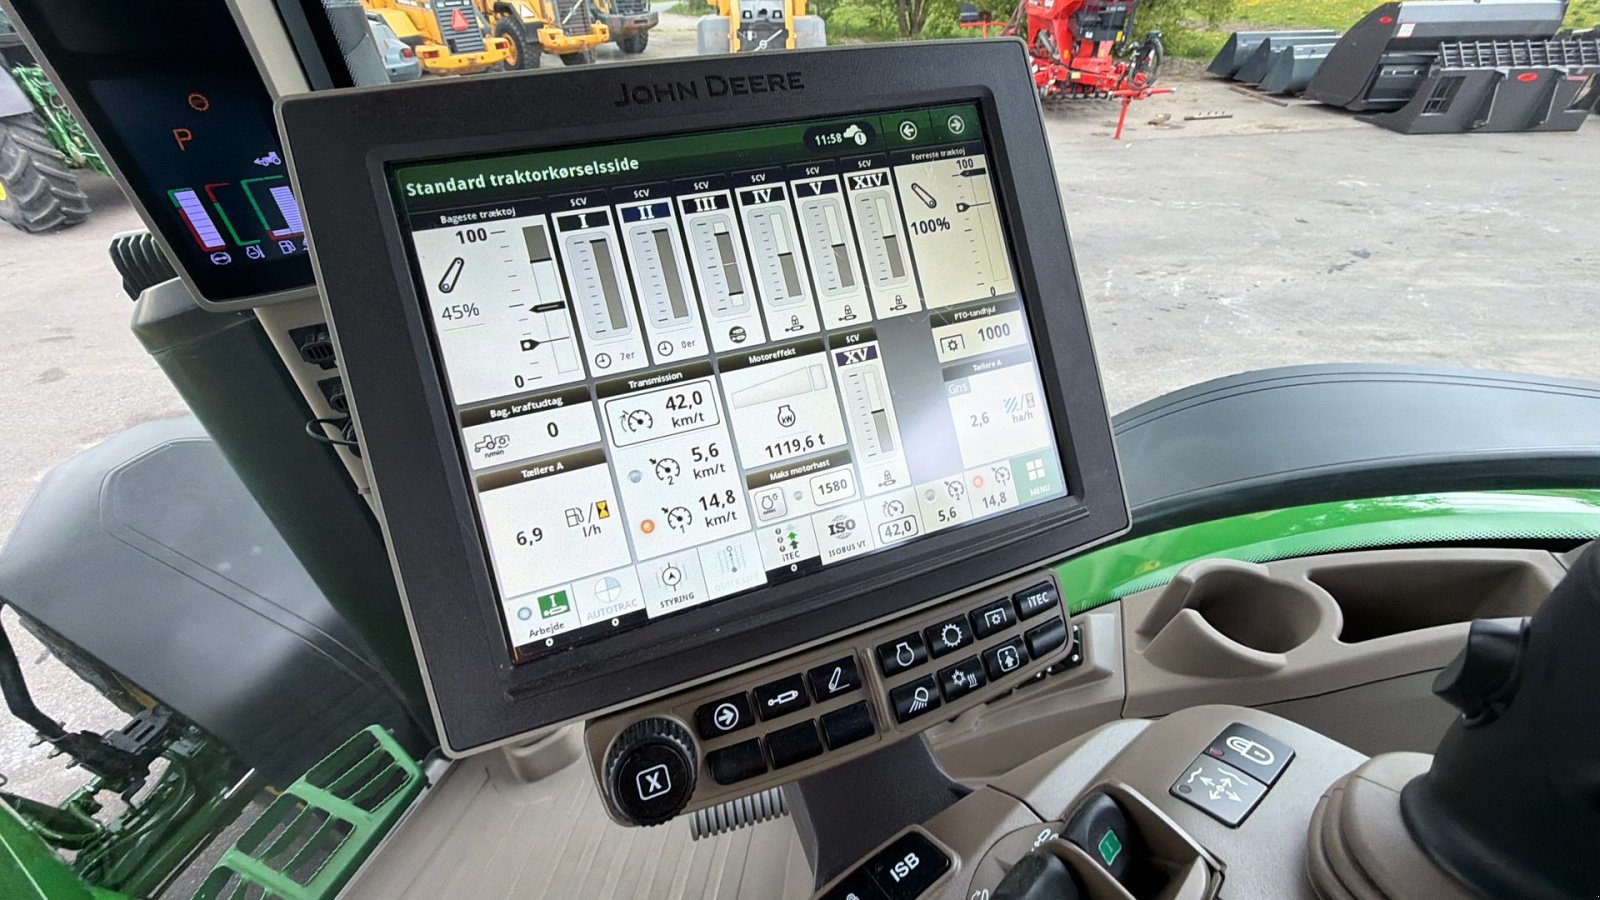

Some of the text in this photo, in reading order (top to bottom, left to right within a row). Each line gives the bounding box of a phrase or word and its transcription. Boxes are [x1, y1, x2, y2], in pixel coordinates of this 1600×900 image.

[614, 71, 805, 107] JOHN DEERE
[172, 128, 193, 151] P
[815, 132, 842, 146] 11:58
[857, 159, 872, 169] SCV
[911, 151, 939, 162] Forreste
[956, 158, 974, 170] 100
[406, 157, 639, 197] Standard traktorkørselsside
[751, 173, 766, 183] SCV
[805, 166, 820, 176] SCV
[693, 180, 709, 191] SCV
[808, 181, 823, 196] V
[853, 173, 884, 190] XIV
[570, 196, 587, 207] SCV
[633, 188, 650, 199] SCV
[752, 188, 772, 204] IV
[637, 205, 655, 220] II
[694, 196, 718, 212] III
[440, 211, 477, 225] Bageste
[911, 217, 951, 236] 100%
[455, 227, 488, 245] 100
[989, 286, 996, 297] 0
[441, 302, 480, 321] 45%
[954, 305, 996, 321] PTO-tandhjul
[845, 333, 860, 344] SCV
[977, 322, 1011, 343] 1000
[748, 347, 797, 365] Motoreffekt
[844, 348, 869, 365] XV
[996, 359, 1003, 367] A
[514, 374, 525, 389] 0
[628, 371, 684, 390] Transmission
[511, 396, 564, 414] kraftudtag
[665, 390, 704, 411] 42,0
[671, 411, 706, 429] km/t
[970, 411, 991, 428] 2,6
[1011, 410, 1035, 425] ha/h
[546, 421, 559, 438] 0
[691, 442, 720, 463] 5,6
[764, 433, 827, 459] 1119,6 t
[520, 461, 565, 479] Tællere A
[692, 462, 727, 480] km/t
[769, 459, 831, 482] Maks motorhast
[817, 478, 848, 497] 1580
[1028, 484, 1052, 498] MENU
[698, 488, 736, 511] 14,8
[982, 491, 1008, 510] 14,8
[705, 510, 738, 528] km/t
[938, 505, 957, 523] 5,6
[516, 526, 544, 547] 6,9
[828, 518, 857, 537] ISO
[884, 519, 913, 539] 42,0
[782, 550, 801, 563] iTEC
[828, 540, 867, 558] ISOBUS VT
[659, 592, 696, 609] STYRING
[1026, 591, 1050, 609] iTEC
[587, 599, 638, 622] AUTOTRAC
[529, 621, 566, 639] Arbejde
[645, 770, 663, 793] X
[889, 852, 920, 883] ISB
